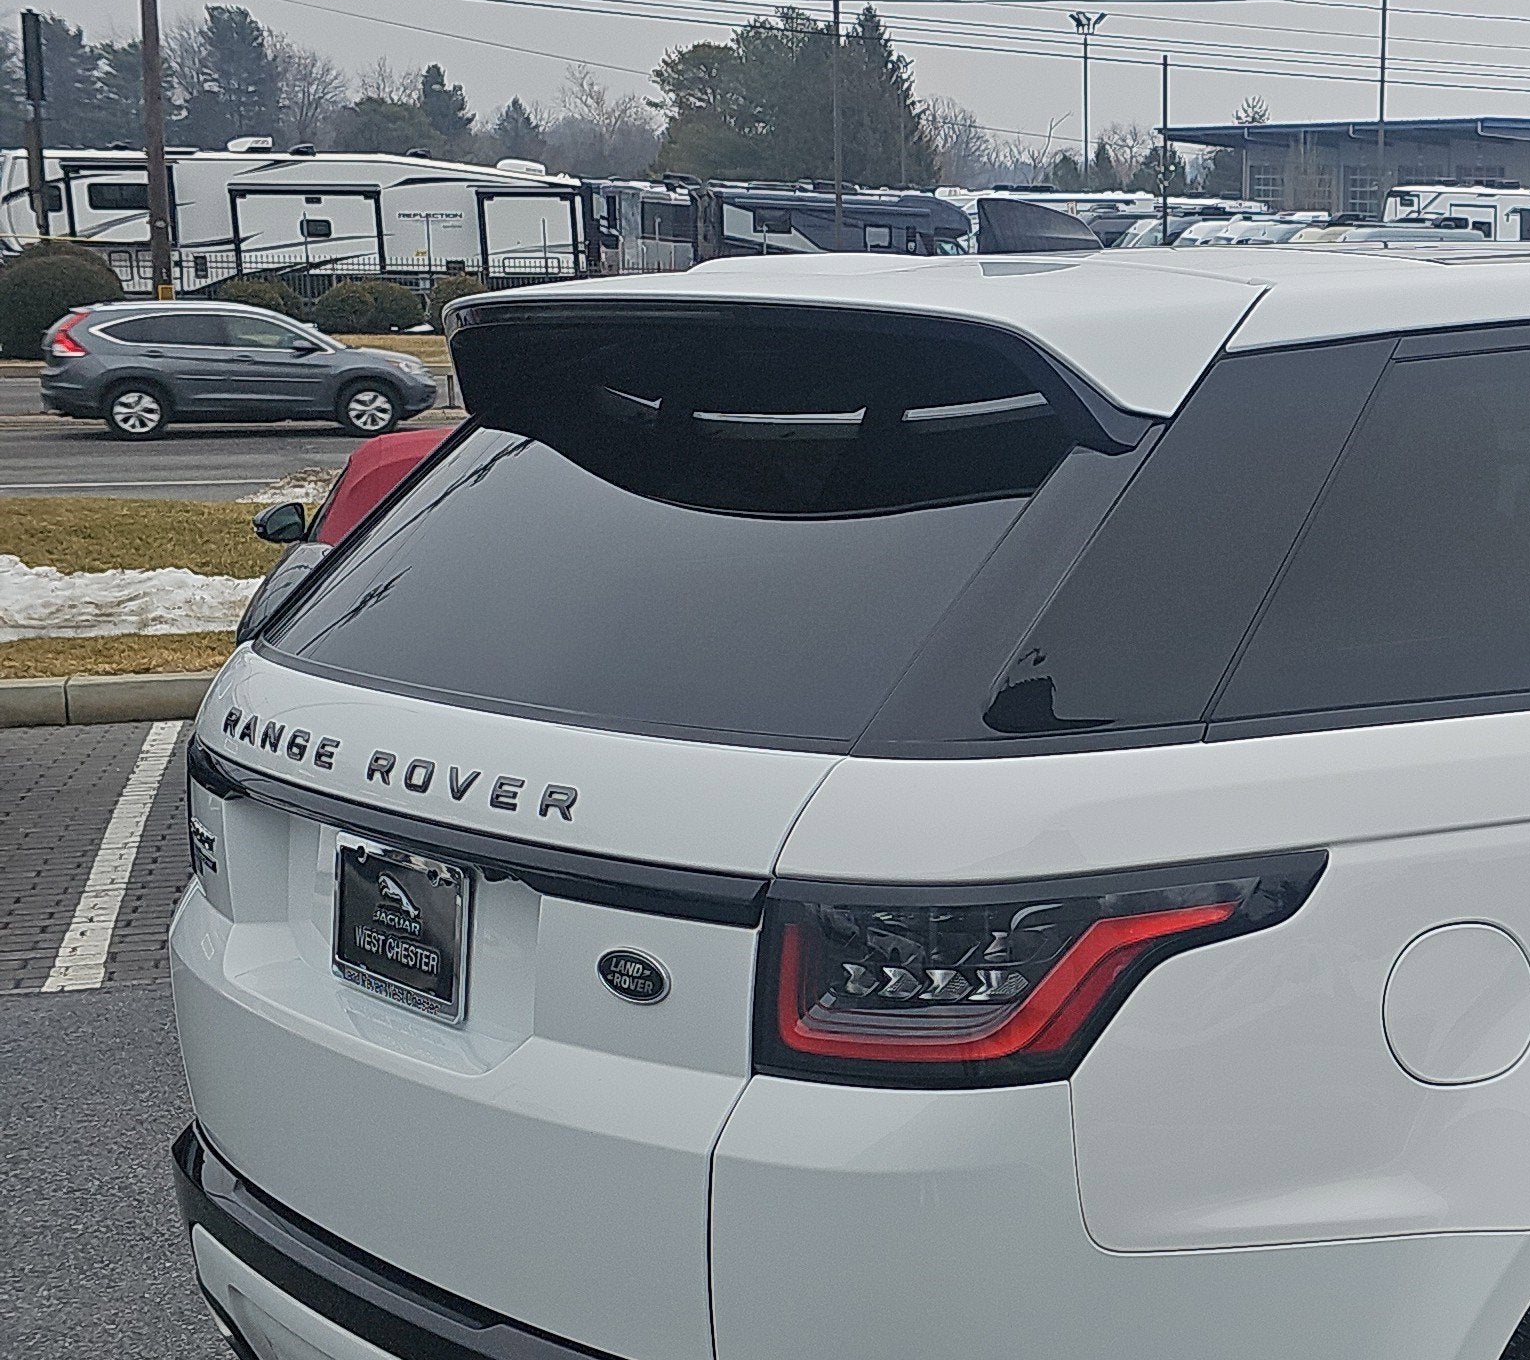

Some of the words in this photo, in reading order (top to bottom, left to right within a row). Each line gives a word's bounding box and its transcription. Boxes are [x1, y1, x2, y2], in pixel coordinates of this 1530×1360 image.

[222, 707, 341, 770] RANGE
[366, 749, 579, 822] ROVER
[373, 910, 420, 935] JAGUAR
[355, 926, 385, 955] WEST
[385, 938, 439, 975] CHESTER
[610, 958, 643, 977] LAND
[613, 972, 653, 994] ROVER
